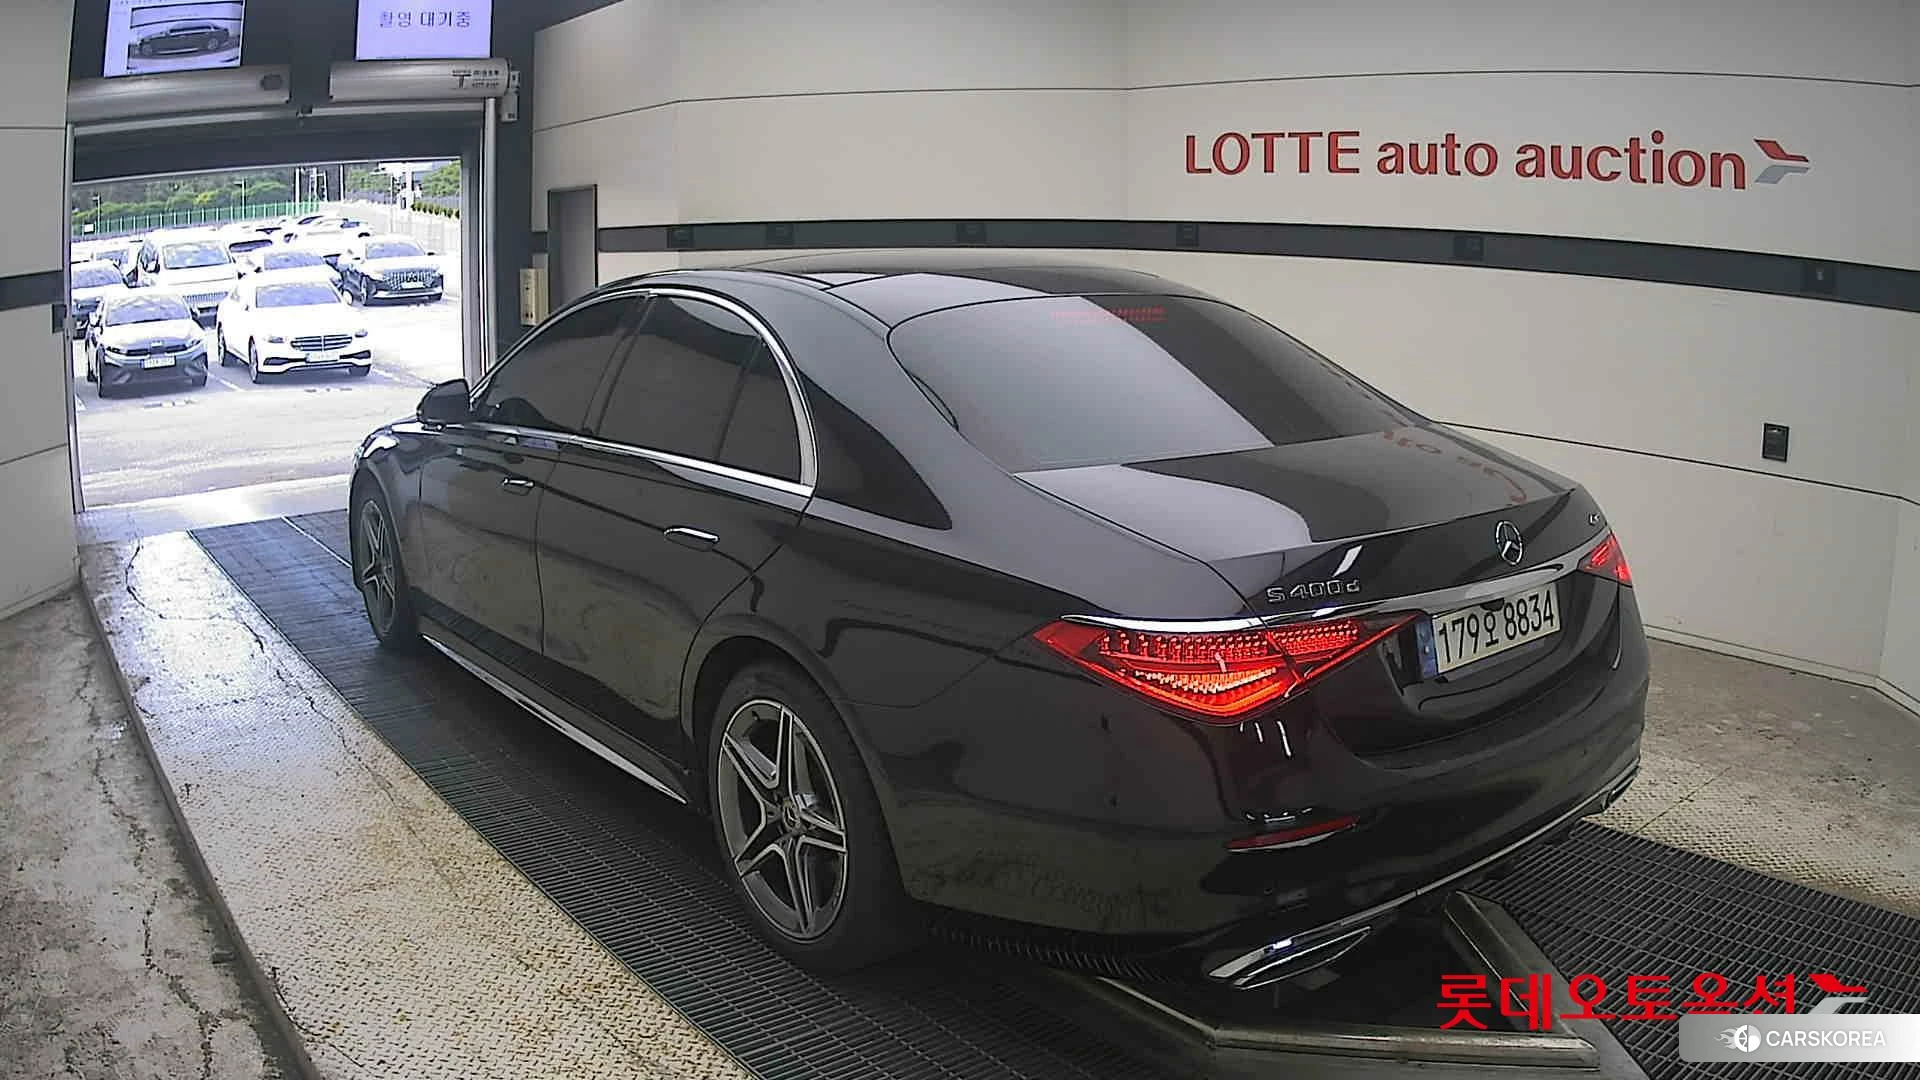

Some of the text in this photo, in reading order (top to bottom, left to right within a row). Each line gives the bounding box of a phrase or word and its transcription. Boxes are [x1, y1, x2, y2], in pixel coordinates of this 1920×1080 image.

[420, 10, 470, 28] 대기중
[1185, 130, 1747, 190] LOTTE auto auction
